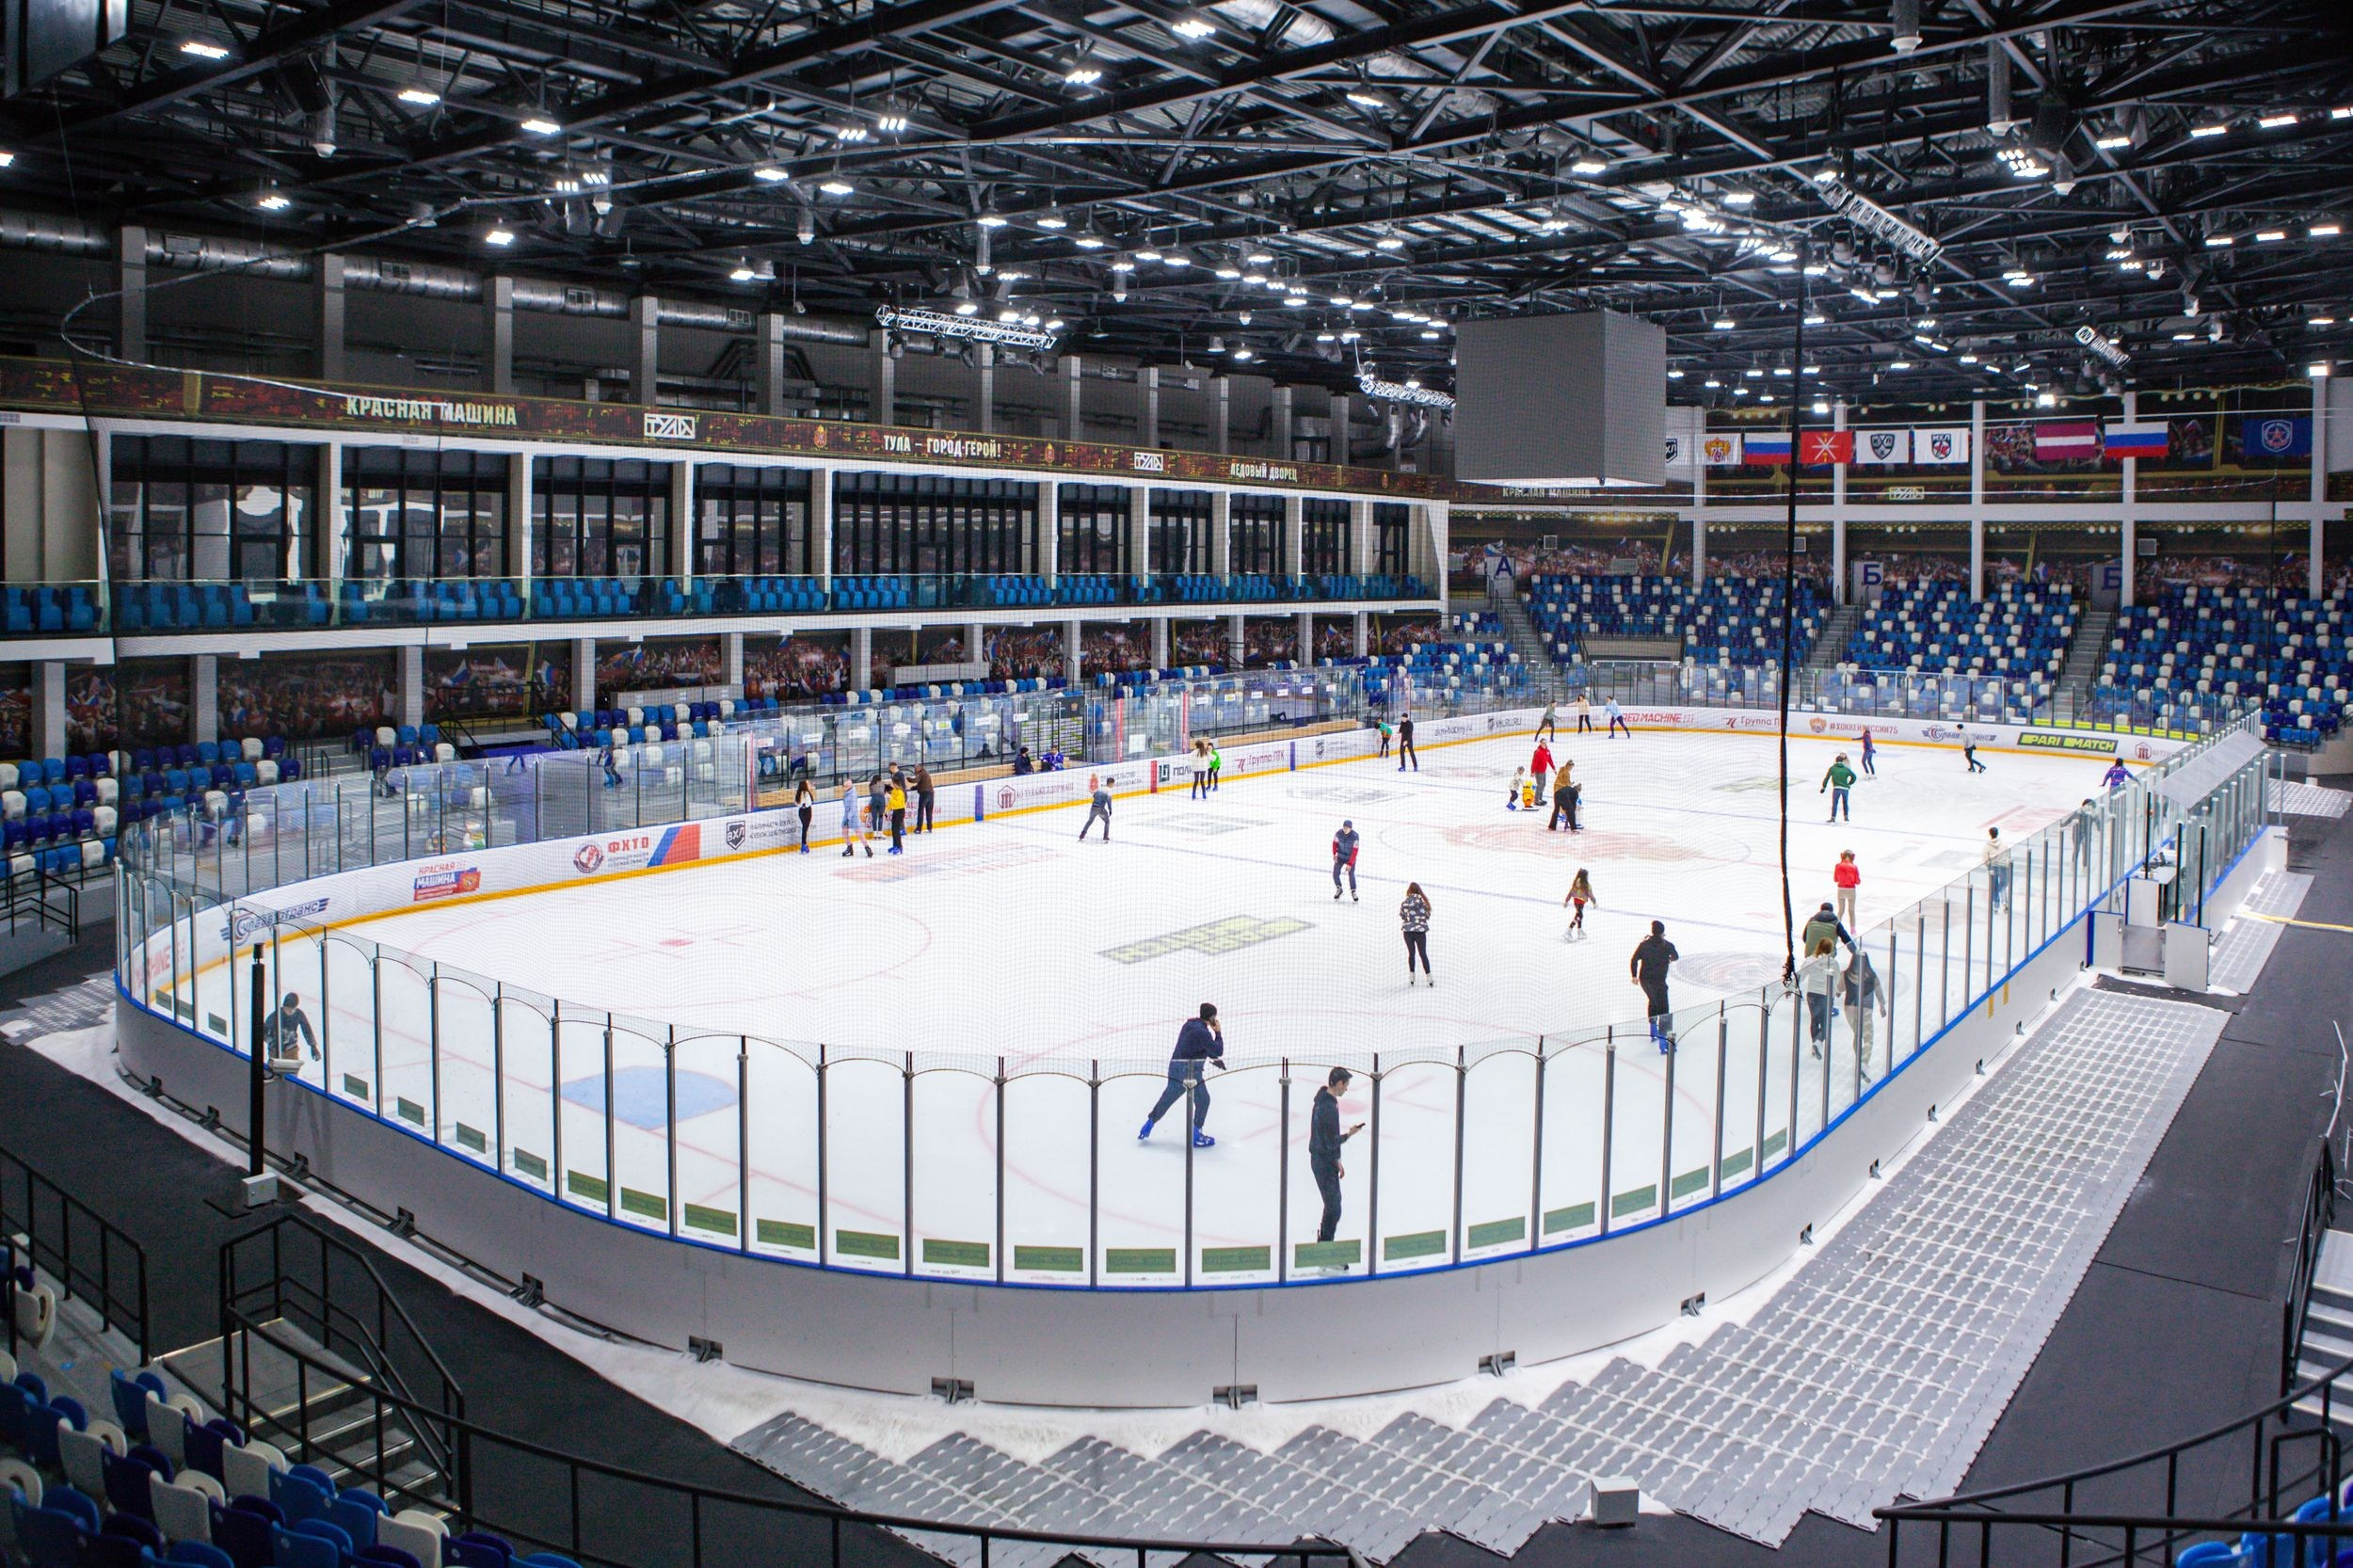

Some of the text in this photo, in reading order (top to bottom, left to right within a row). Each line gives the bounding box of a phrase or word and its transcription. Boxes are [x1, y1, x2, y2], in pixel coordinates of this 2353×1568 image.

[345, 396, 517, 426] КРАСНАЯ МАШИНА
[884, 435, 911, 452] ТУЛА
[1230, 461, 1298, 483] ЛЕДОВЫЙ ДВОРЕЦ
[1864, 565, 1881, 585] Б
[1641, 712, 1682, 723] MACHINE
[1741, 715, 1771, 727] Группа
[2029, 735, 2116, 752] PARI MATCH
[727, 826, 745, 842] ВХЛ
[608, 836, 649, 854] ФХТО
[418, 861, 456, 876] КРАСНАЯ
[416, 872, 456, 889] МАШИНА
